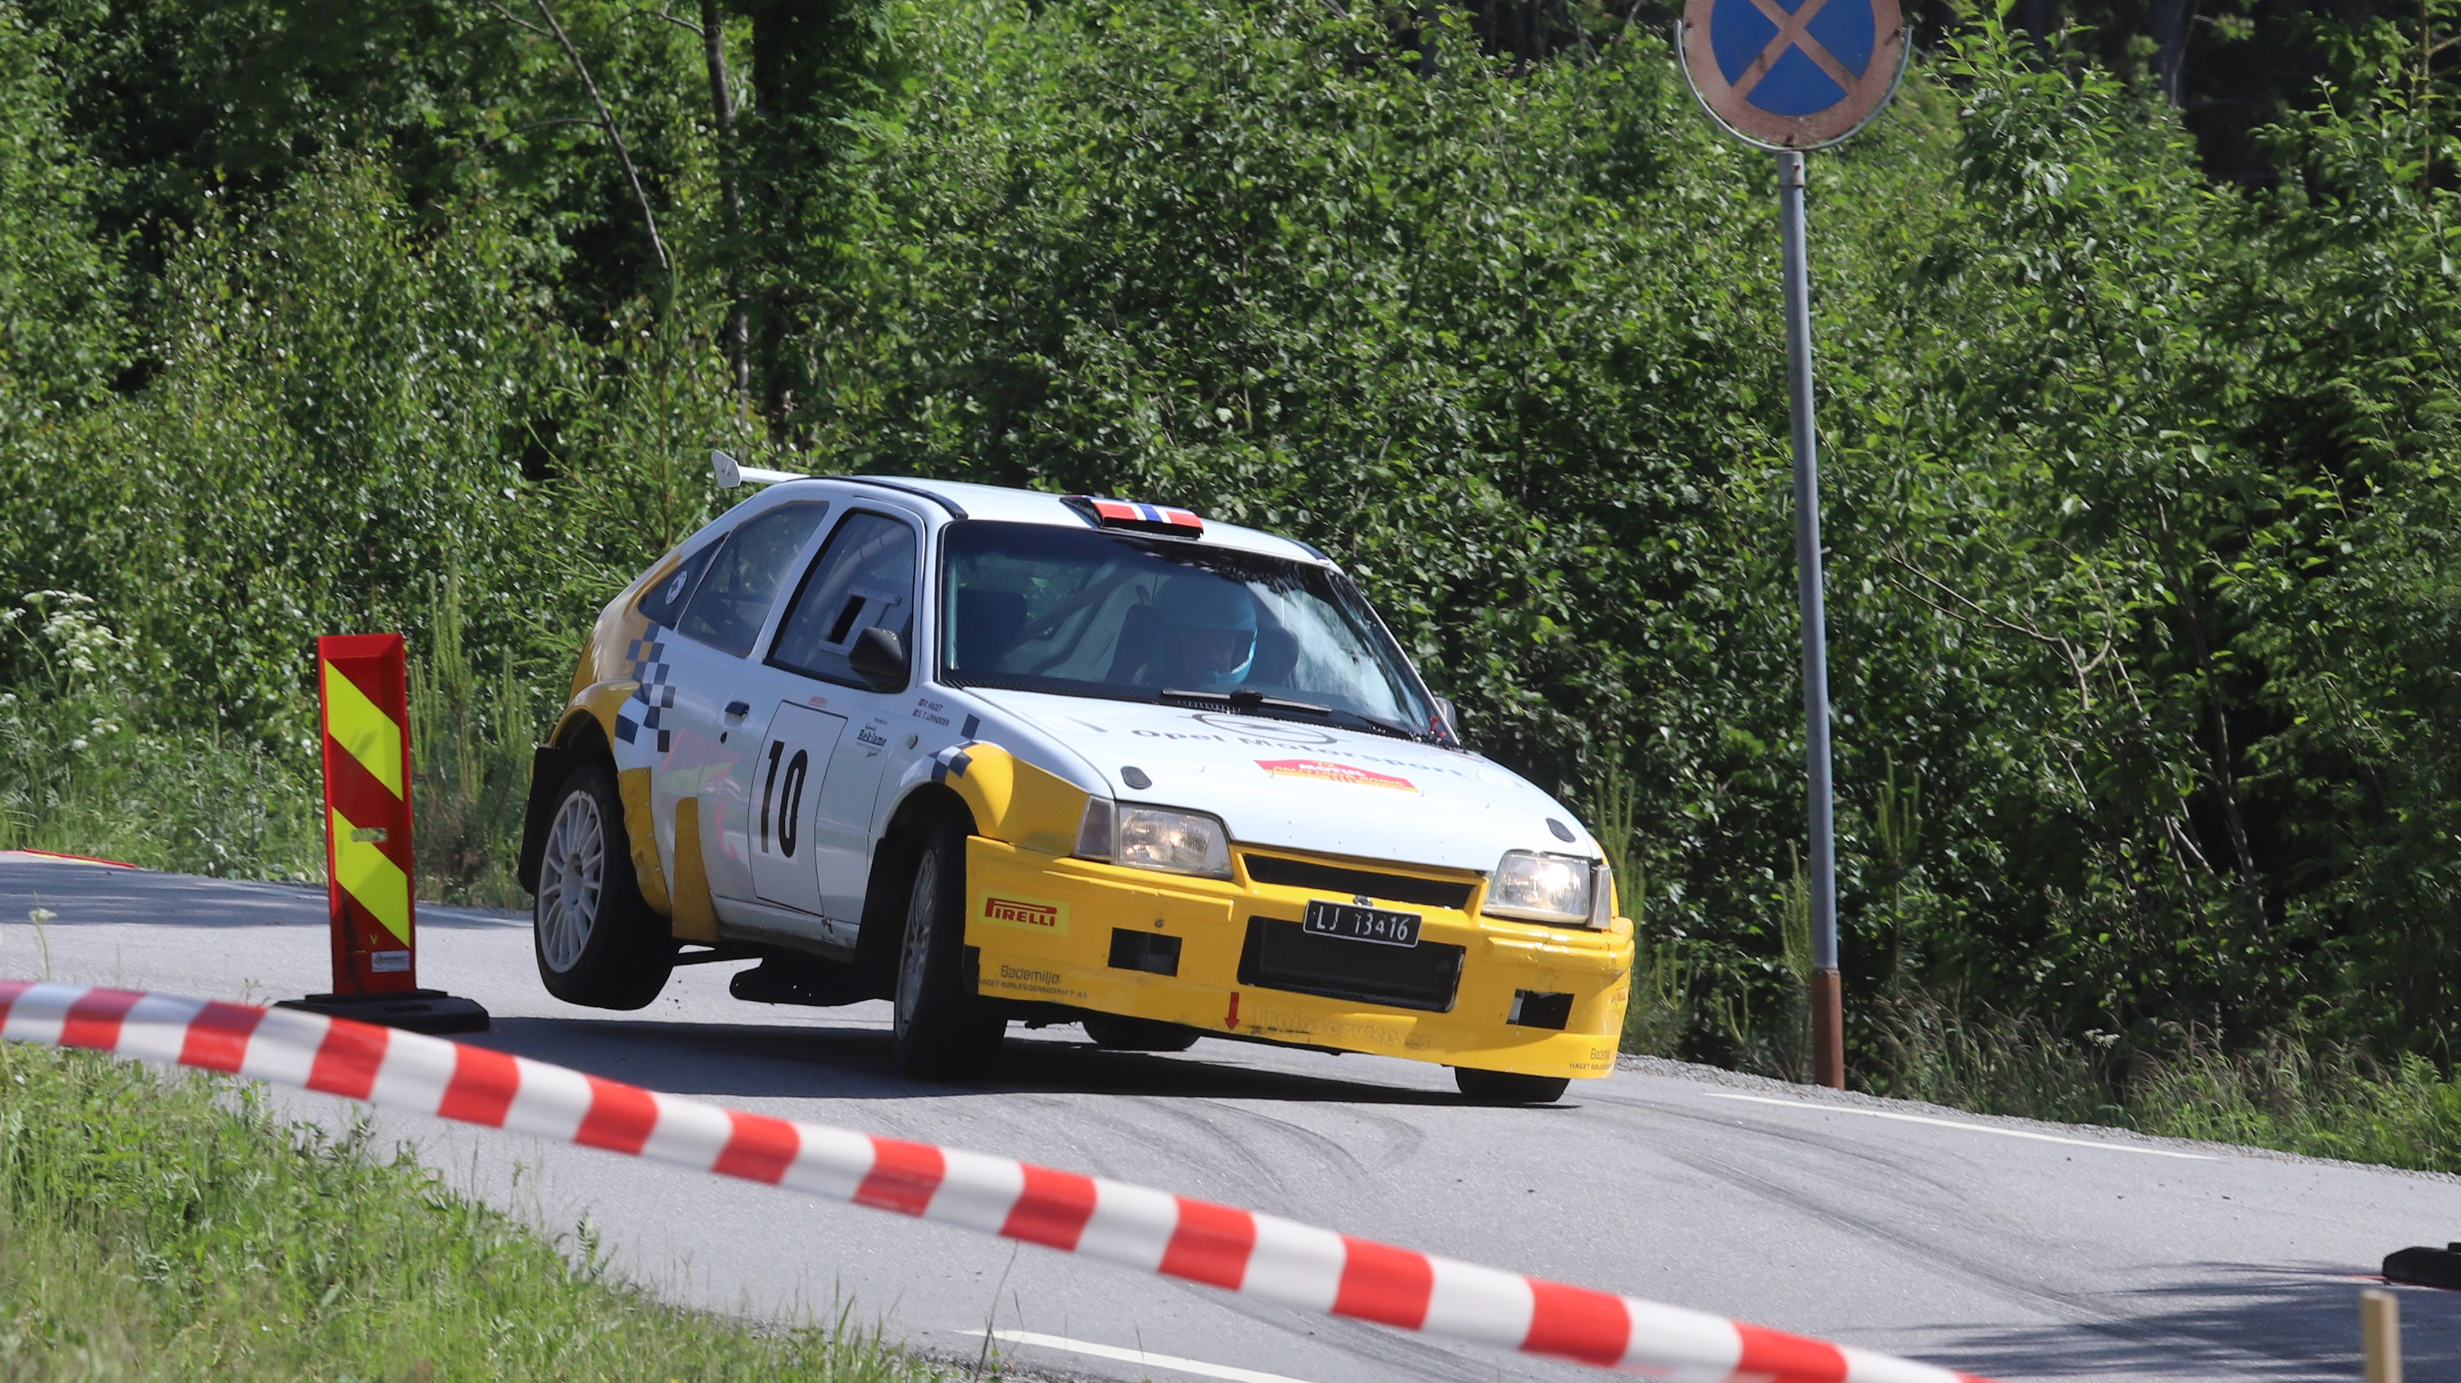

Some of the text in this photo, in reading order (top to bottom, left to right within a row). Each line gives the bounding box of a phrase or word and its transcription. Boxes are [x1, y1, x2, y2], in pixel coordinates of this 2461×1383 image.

[857, 729, 888, 746] Reklame
[1131, 729, 1467, 778] Opel Motorsport
[760, 740, 808, 858] 10
[985, 897, 1057, 927] PIRELLI
[1316, 905, 1411, 940] LJ 13416
[1000, 964, 1061, 987] Bademiljø
